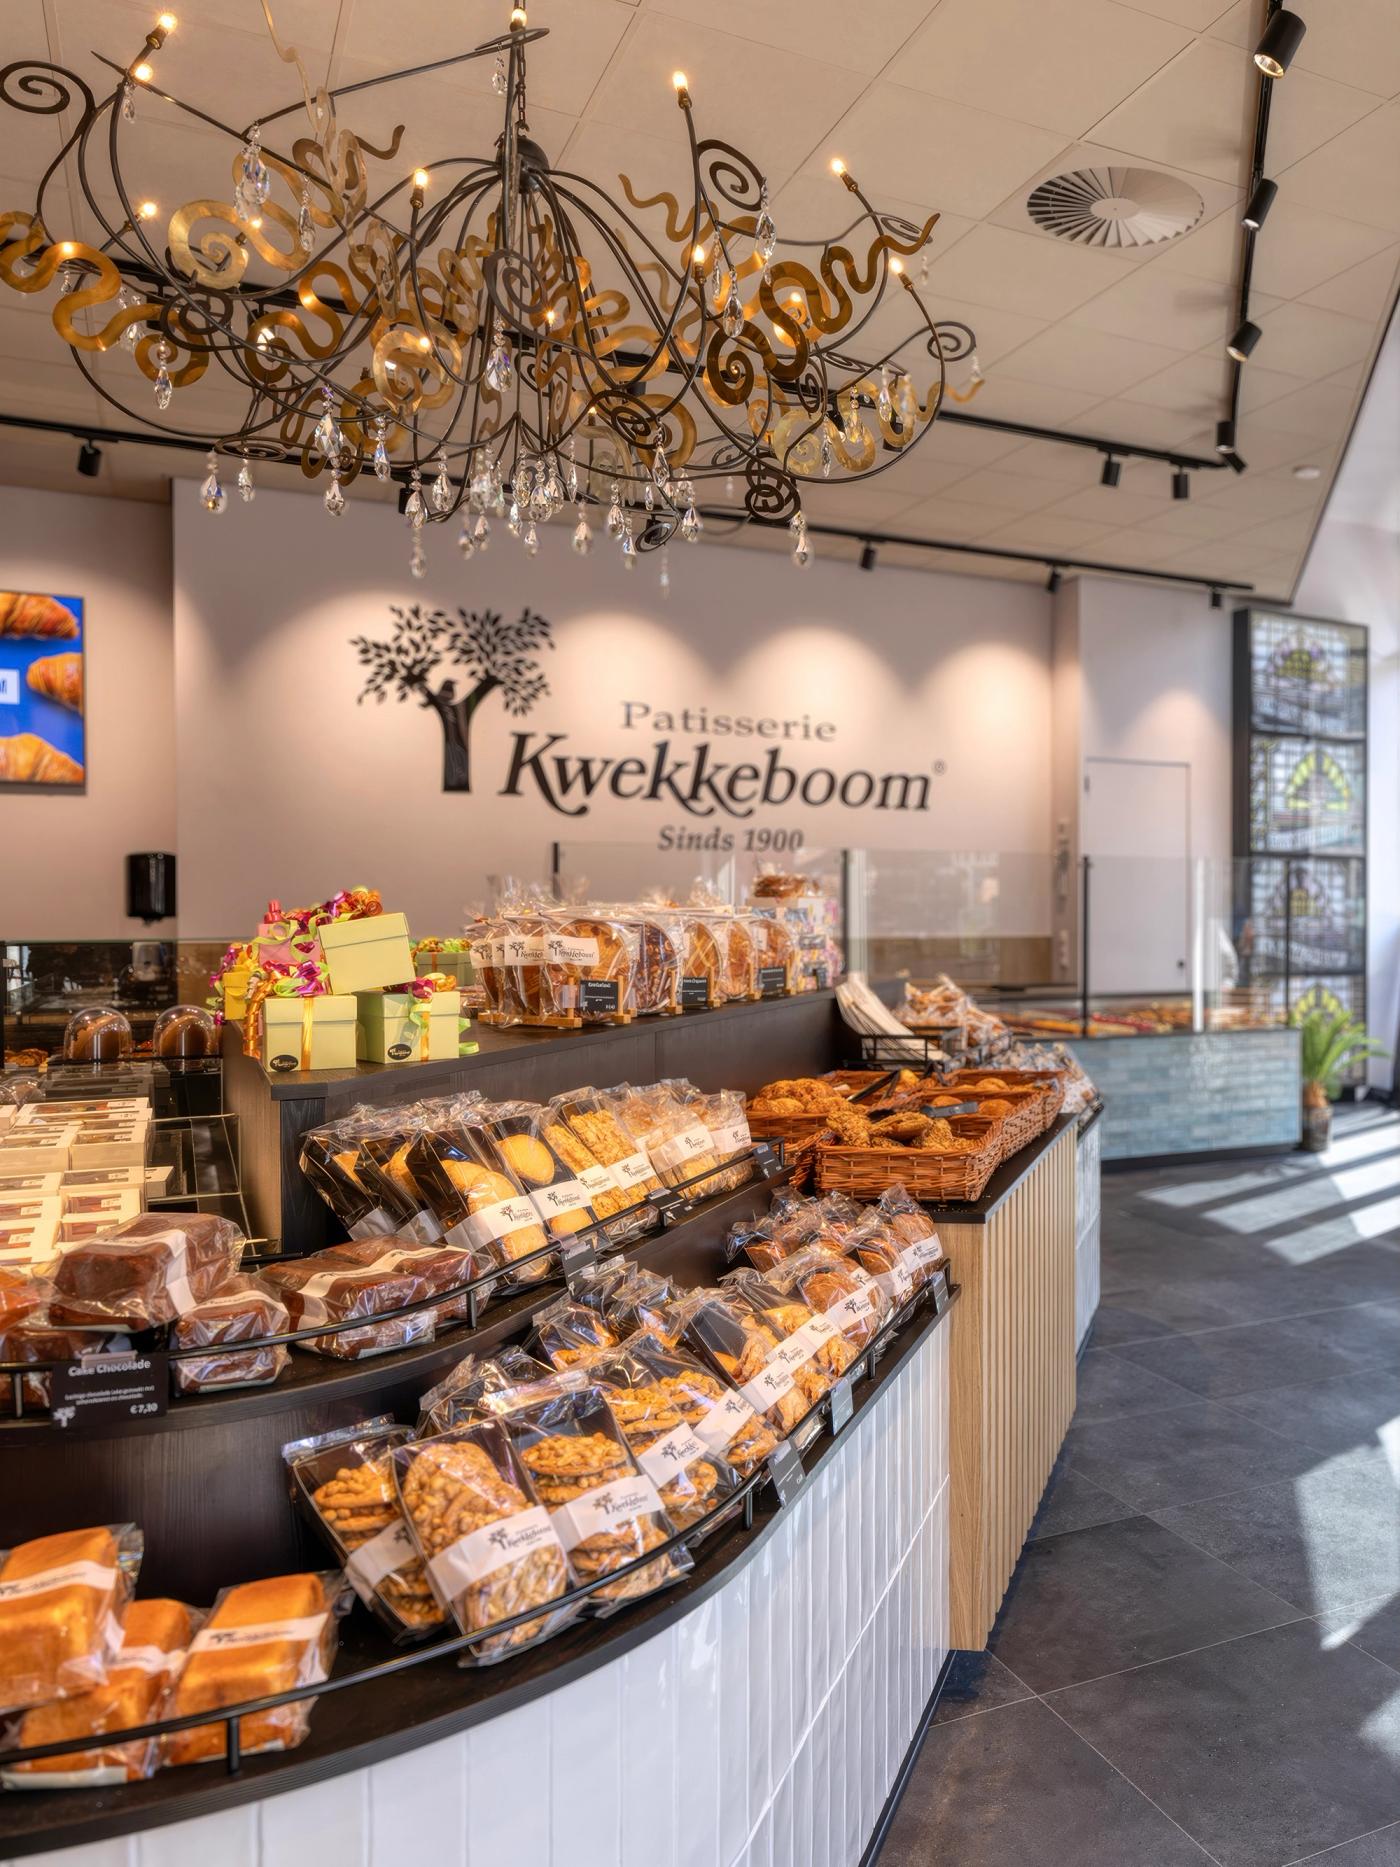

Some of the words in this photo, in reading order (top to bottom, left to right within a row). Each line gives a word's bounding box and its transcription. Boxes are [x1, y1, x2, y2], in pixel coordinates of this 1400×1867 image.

[619, 701, 837, 742] Patisserie
[656, 825, 735, 853] Sinds
[743, 828, 804, 854] 1900
[96, 1359, 151, 1375] Chocolade
